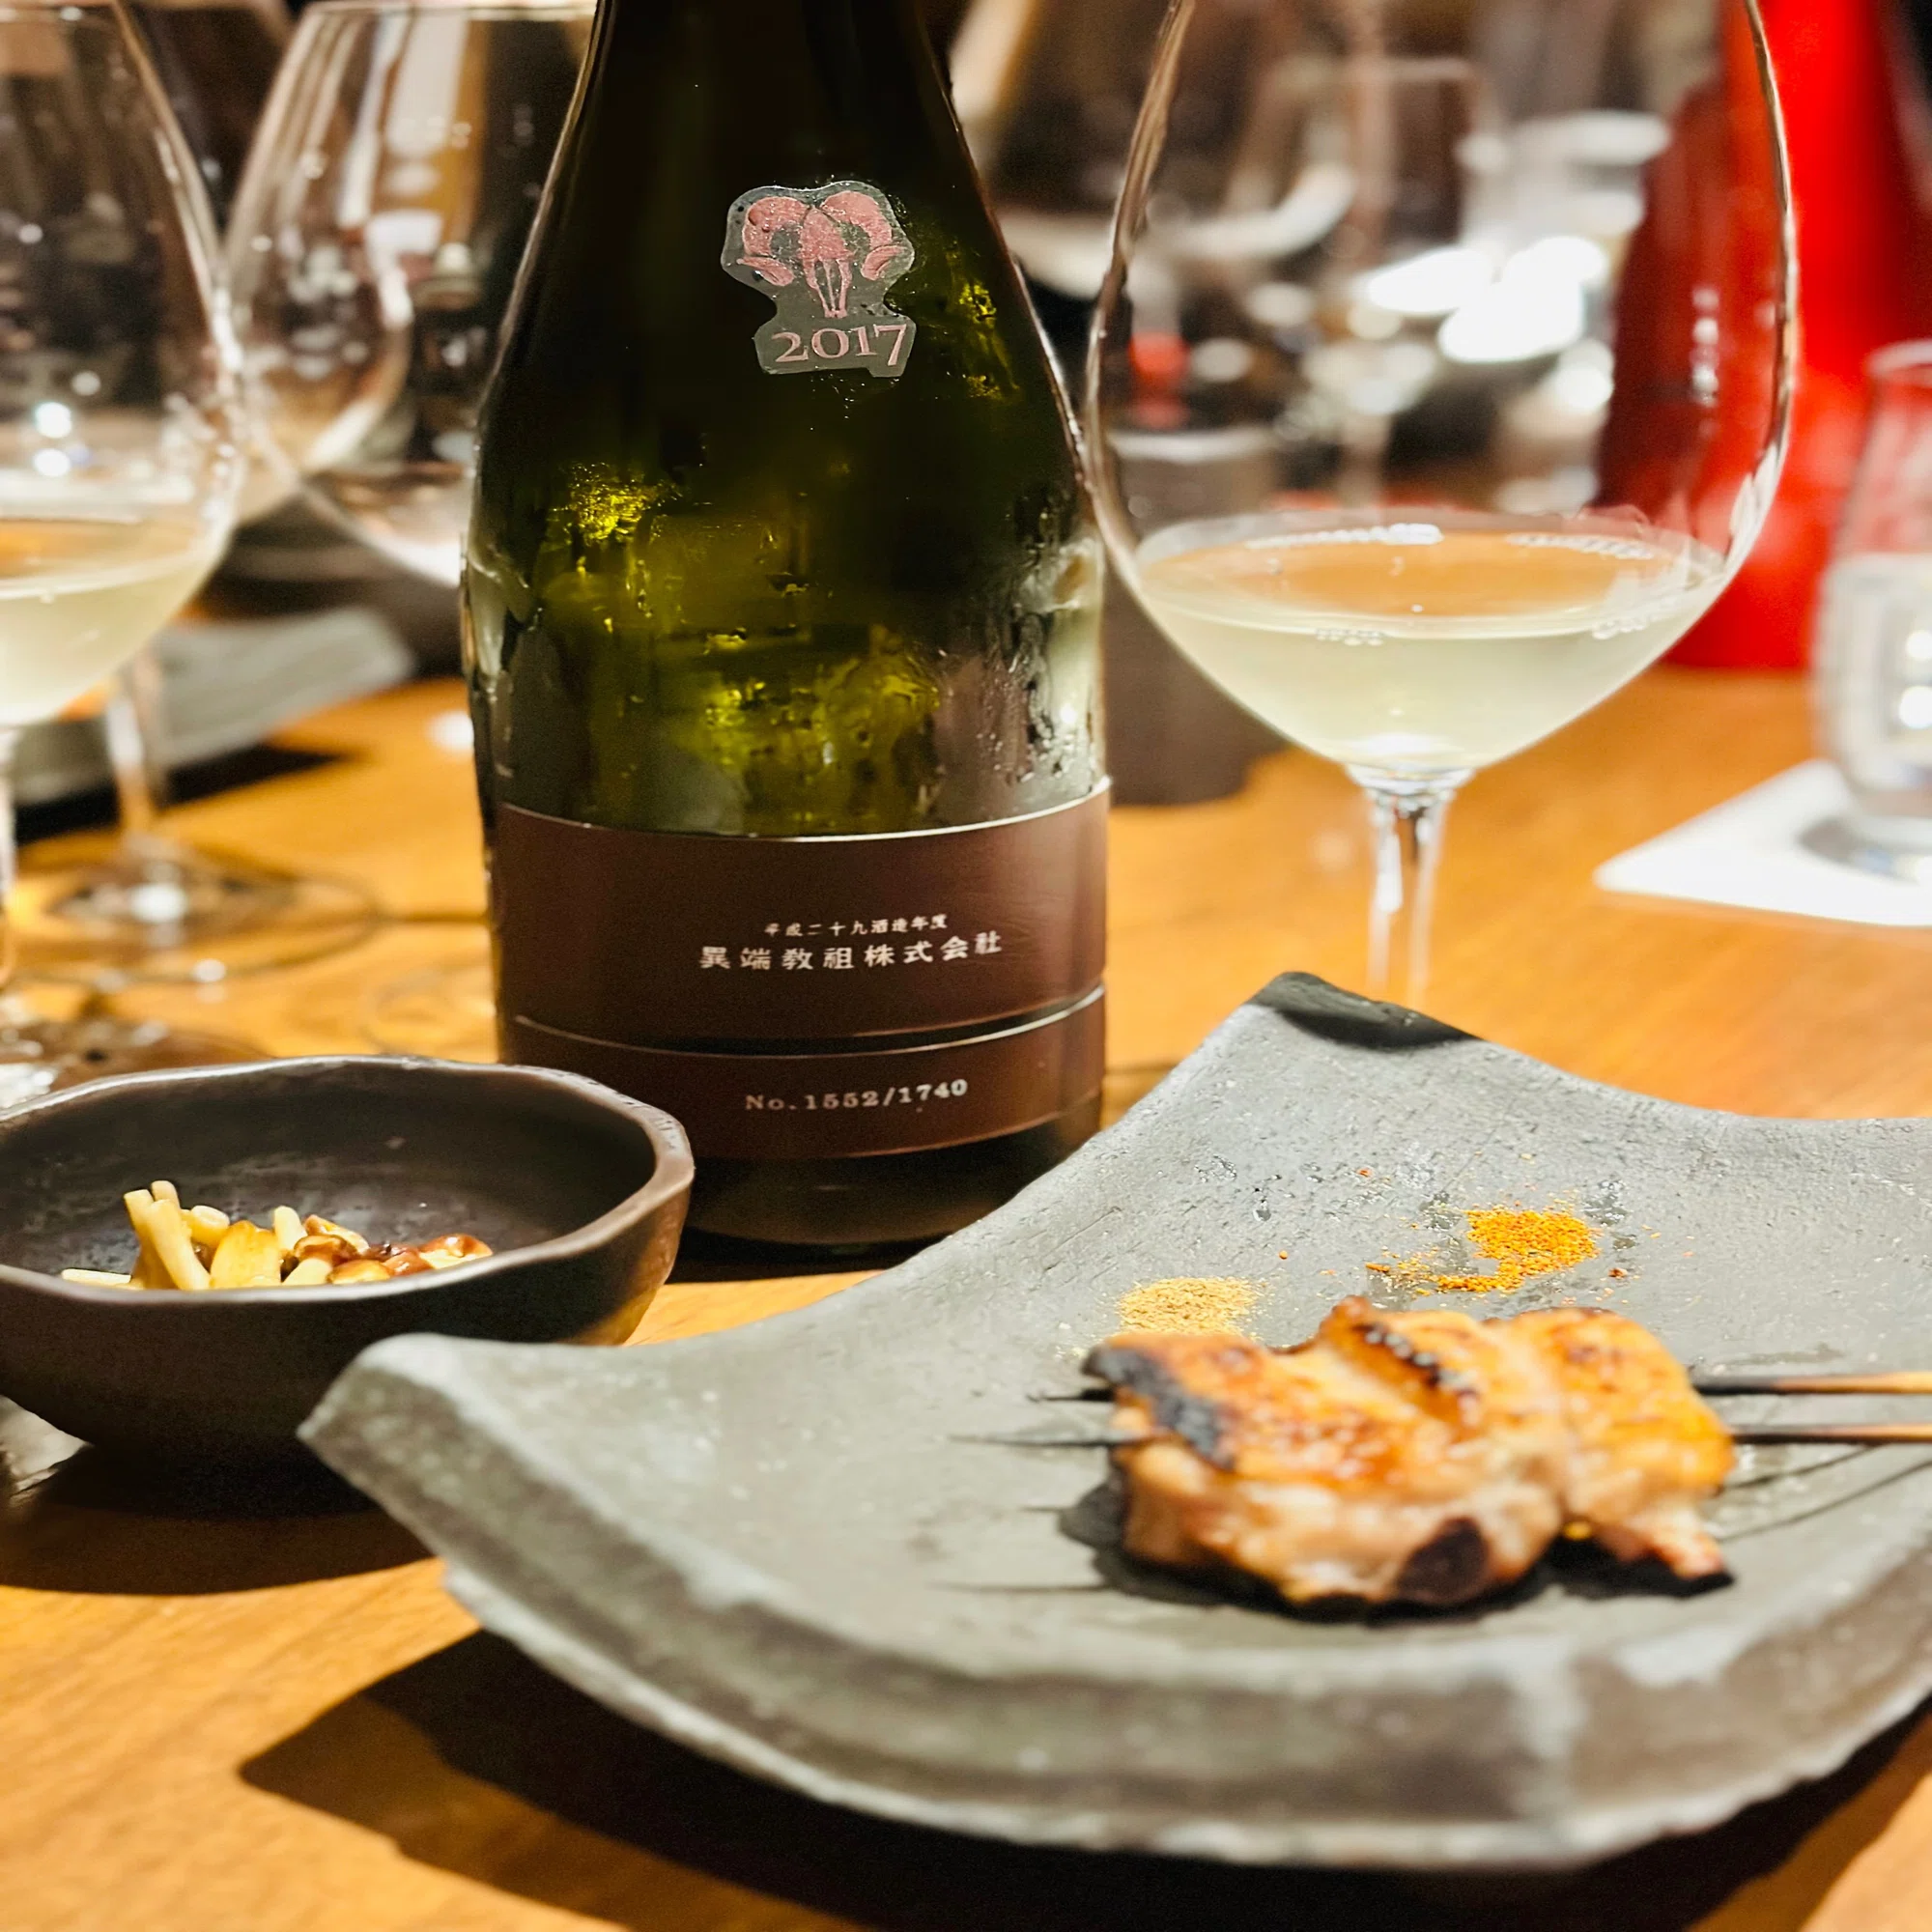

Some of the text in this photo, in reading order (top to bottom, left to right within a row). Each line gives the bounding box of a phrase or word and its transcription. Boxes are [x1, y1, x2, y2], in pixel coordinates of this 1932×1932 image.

[772, 324, 907, 366] 2017
[764, 914, 949, 936] 平成二十九酒造年度
[698, 930, 1003, 970] 異端教祖株式会社
